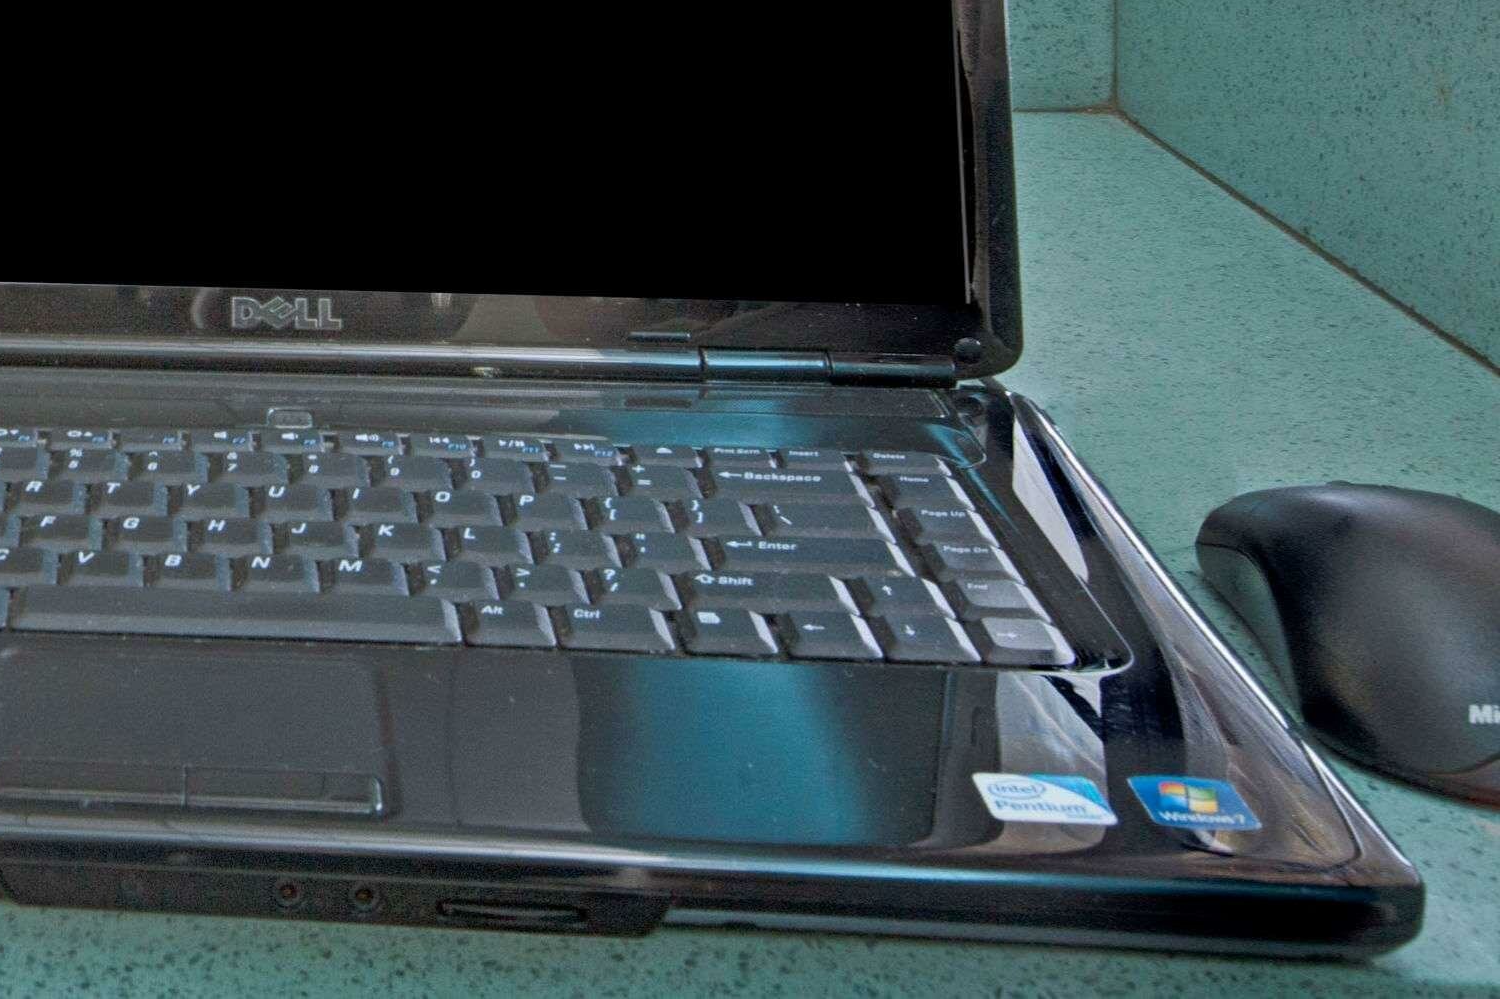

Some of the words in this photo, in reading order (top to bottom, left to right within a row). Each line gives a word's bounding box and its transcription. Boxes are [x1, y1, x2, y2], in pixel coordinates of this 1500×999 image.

[231, 296, 342, 330] DELL
[744, 472, 822, 483] Backspace
[899, 475, 930, 483] Home
[25, 480, 44, 493] R
[106, 481, 121, 495] T
[186, 483, 201, 497] Y
[268, 485, 286, 499] U
[352, 487, 361, 500] I
[434, 490, 451, 503] O
[519, 494, 535, 507] P
[921, 509, 948, 518] Page
[950, 510, 967, 518] Up
[39, 514, 57, 528] F
[123, 516, 141, 530] G
[207, 519, 226, 533] H
[290, 522, 307, 535] J
[377, 523, 395, 537] K
[463, 526, 477, 541] L
[757, 542, 798, 551] Enter
[942, 544, 971, 554] Page
[973, 546, 989, 554] Dn
[77, 551, 95, 565] V
[164, 553, 183, 568] B
[251, 555, 271, 569] N
[338, 558, 363, 573] M
[603, 568, 617, 581] ?
[718, 575, 755, 586] Shift
[966, 582, 989, 591] End
[481, 604, 504, 616] Alt
[573, 608, 602, 619] Ctrl
[994, 799, 1086, 814] Pentium
[1158, 811, 1235, 824] Windows
